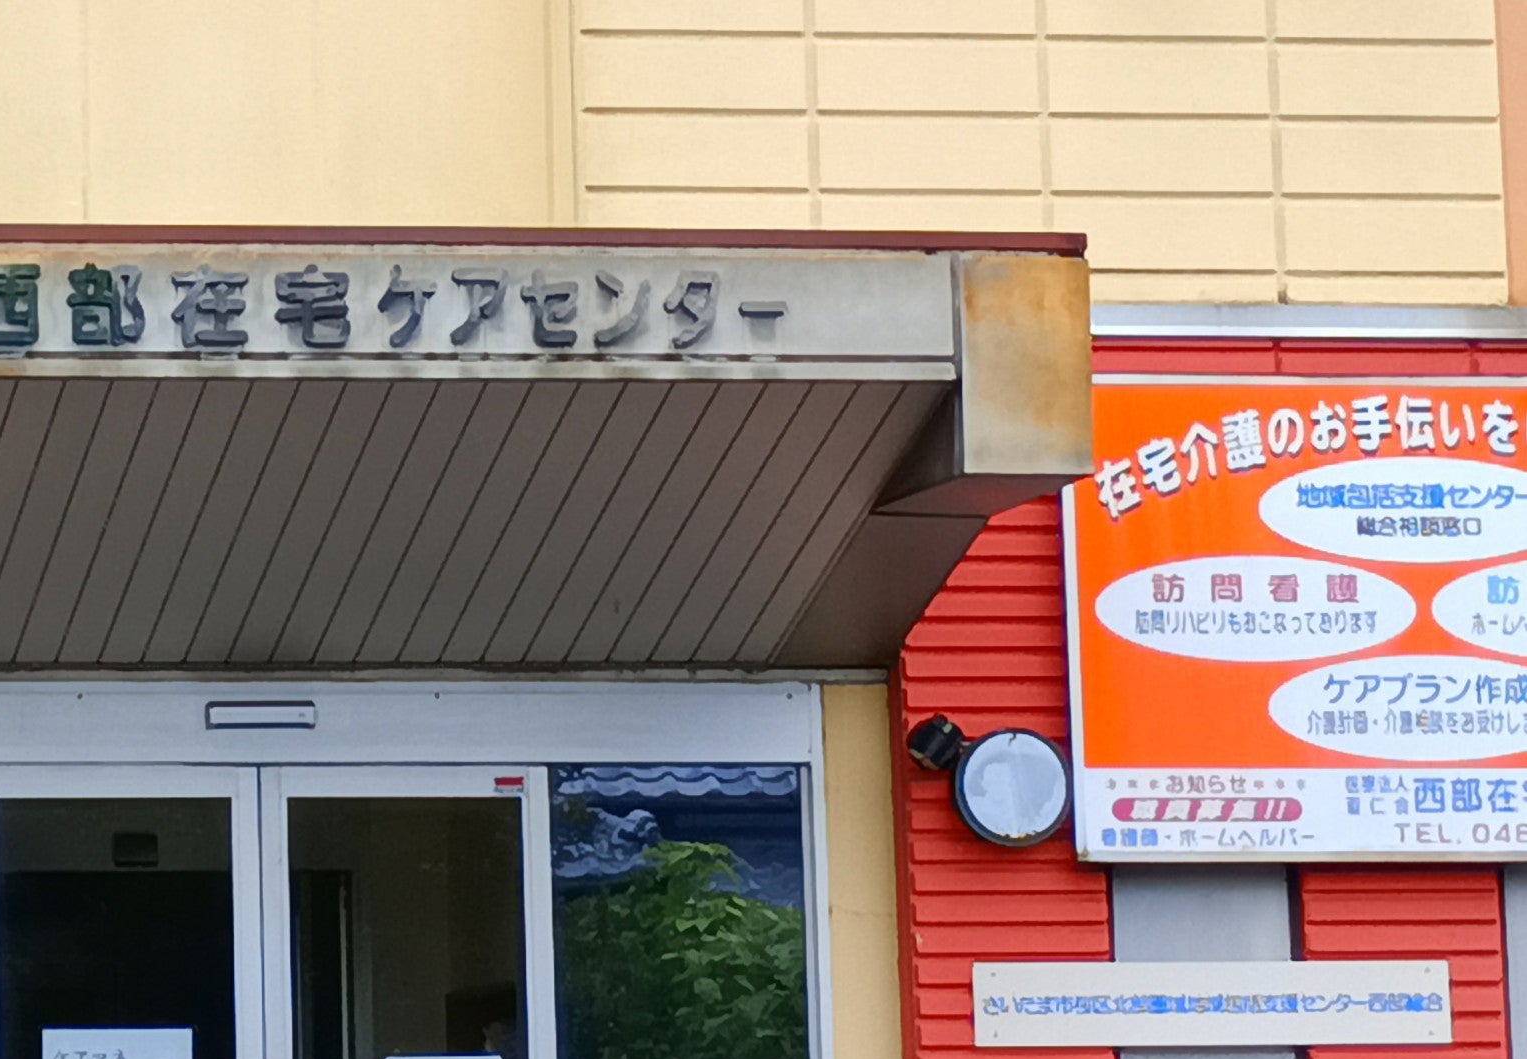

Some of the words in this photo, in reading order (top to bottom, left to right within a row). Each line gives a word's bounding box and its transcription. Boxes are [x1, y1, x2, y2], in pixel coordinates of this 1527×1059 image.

[1094, 394, 1527, 520] 在宅介護のお手伝いを
[1412, 777, 1527, 814] 西部在
